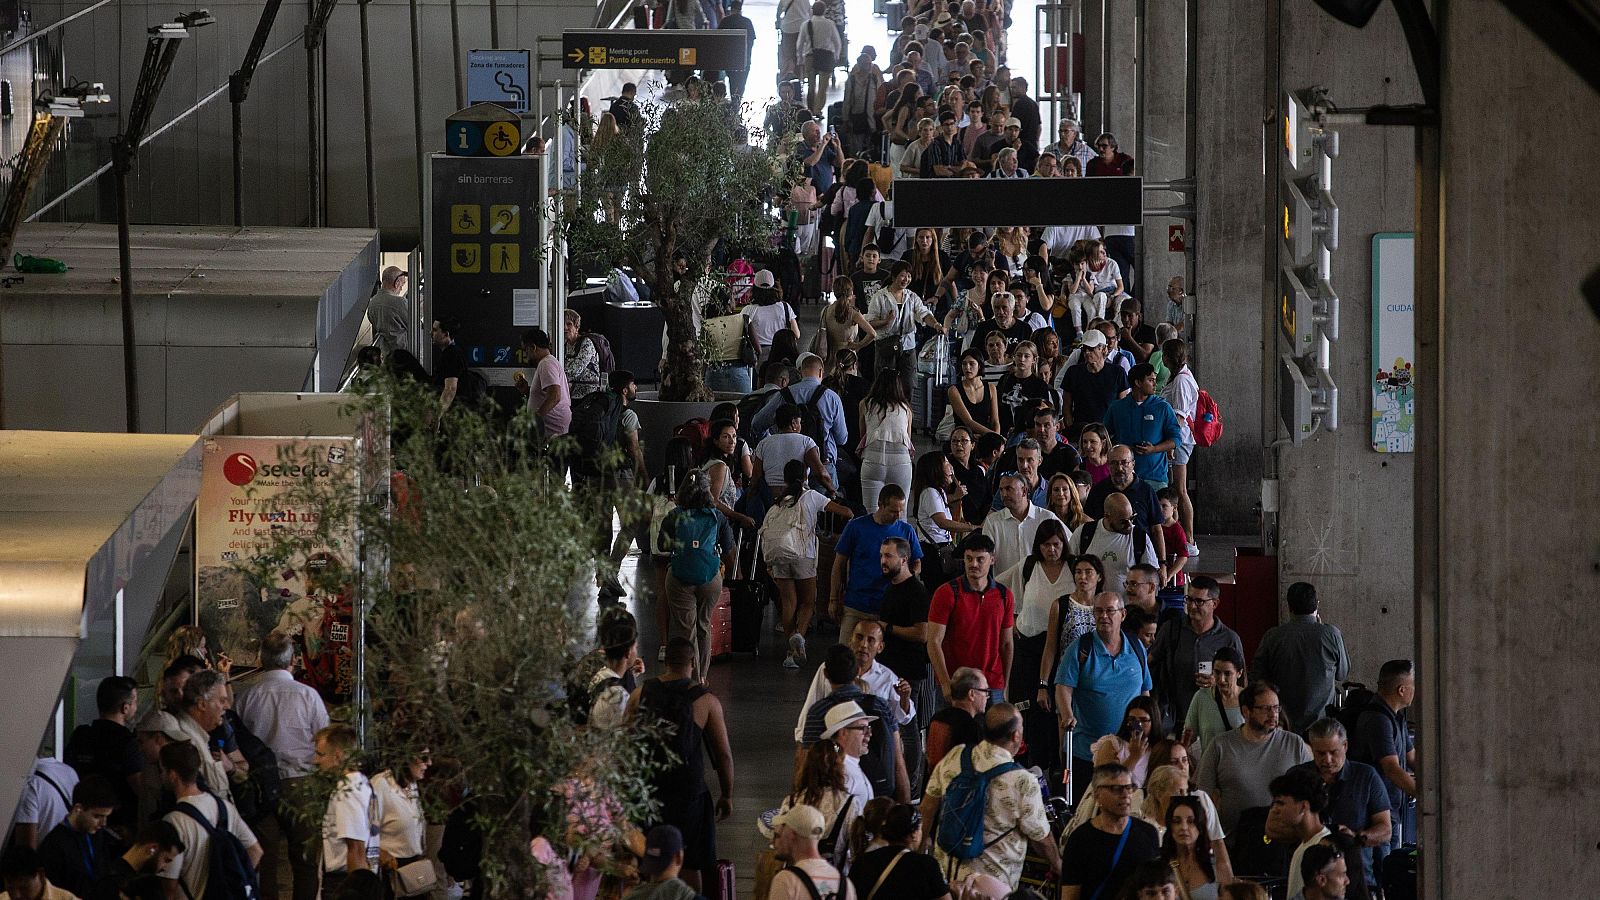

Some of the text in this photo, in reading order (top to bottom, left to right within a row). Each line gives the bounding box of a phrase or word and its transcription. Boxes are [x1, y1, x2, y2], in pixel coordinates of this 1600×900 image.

[609, 47, 632, 56] Meeting
[633, 47, 648, 56] point
[682, 48, 690, 58] P
[609, 56, 630, 64] Punto
[631, 56, 640, 64] de
[641, 56, 676, 64] encuentro
[457, 174, 514, 184] sin barreras
[1386, 304, 1415, 312] CIUDA
[260, 461, 330, 478] selecta
[230, 496, 252, 506] Your
[228, 509, 256, 526] Fly
[233, 527, 251, 536] And
